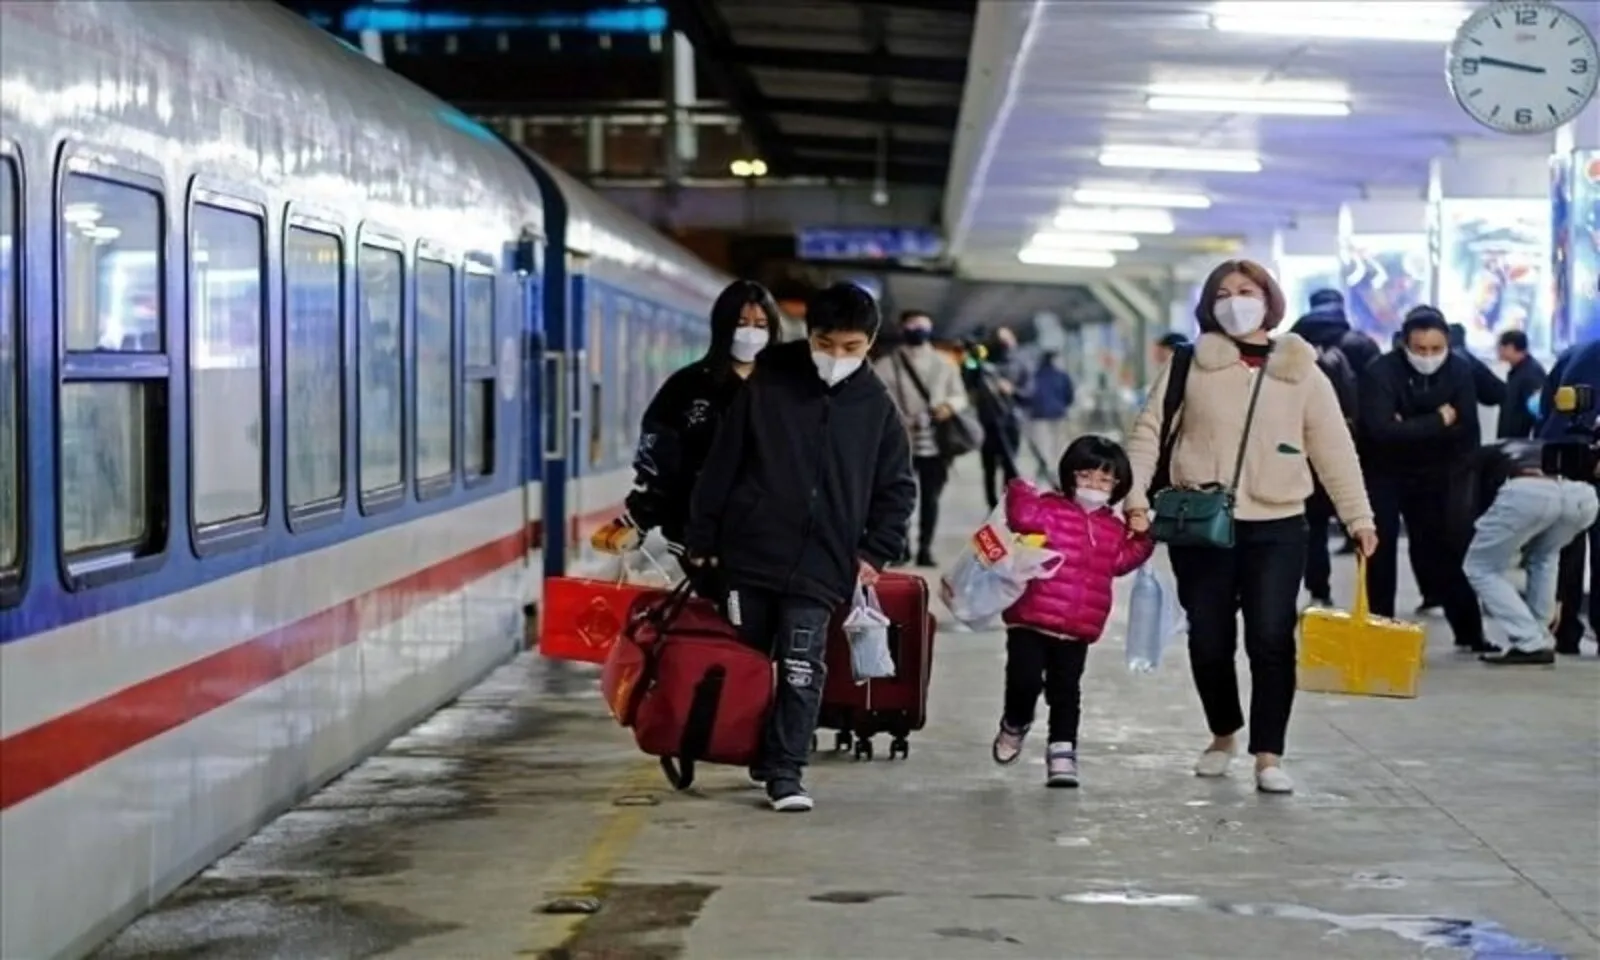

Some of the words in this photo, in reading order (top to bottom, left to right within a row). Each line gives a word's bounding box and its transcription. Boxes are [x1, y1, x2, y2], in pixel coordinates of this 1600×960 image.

[1515, 10, 1538, 26] 12
[1462, 58, 1479, 75] 9
[1571, 58, 1588, 74] 3
[1515, 108, 1533, 125] 6
